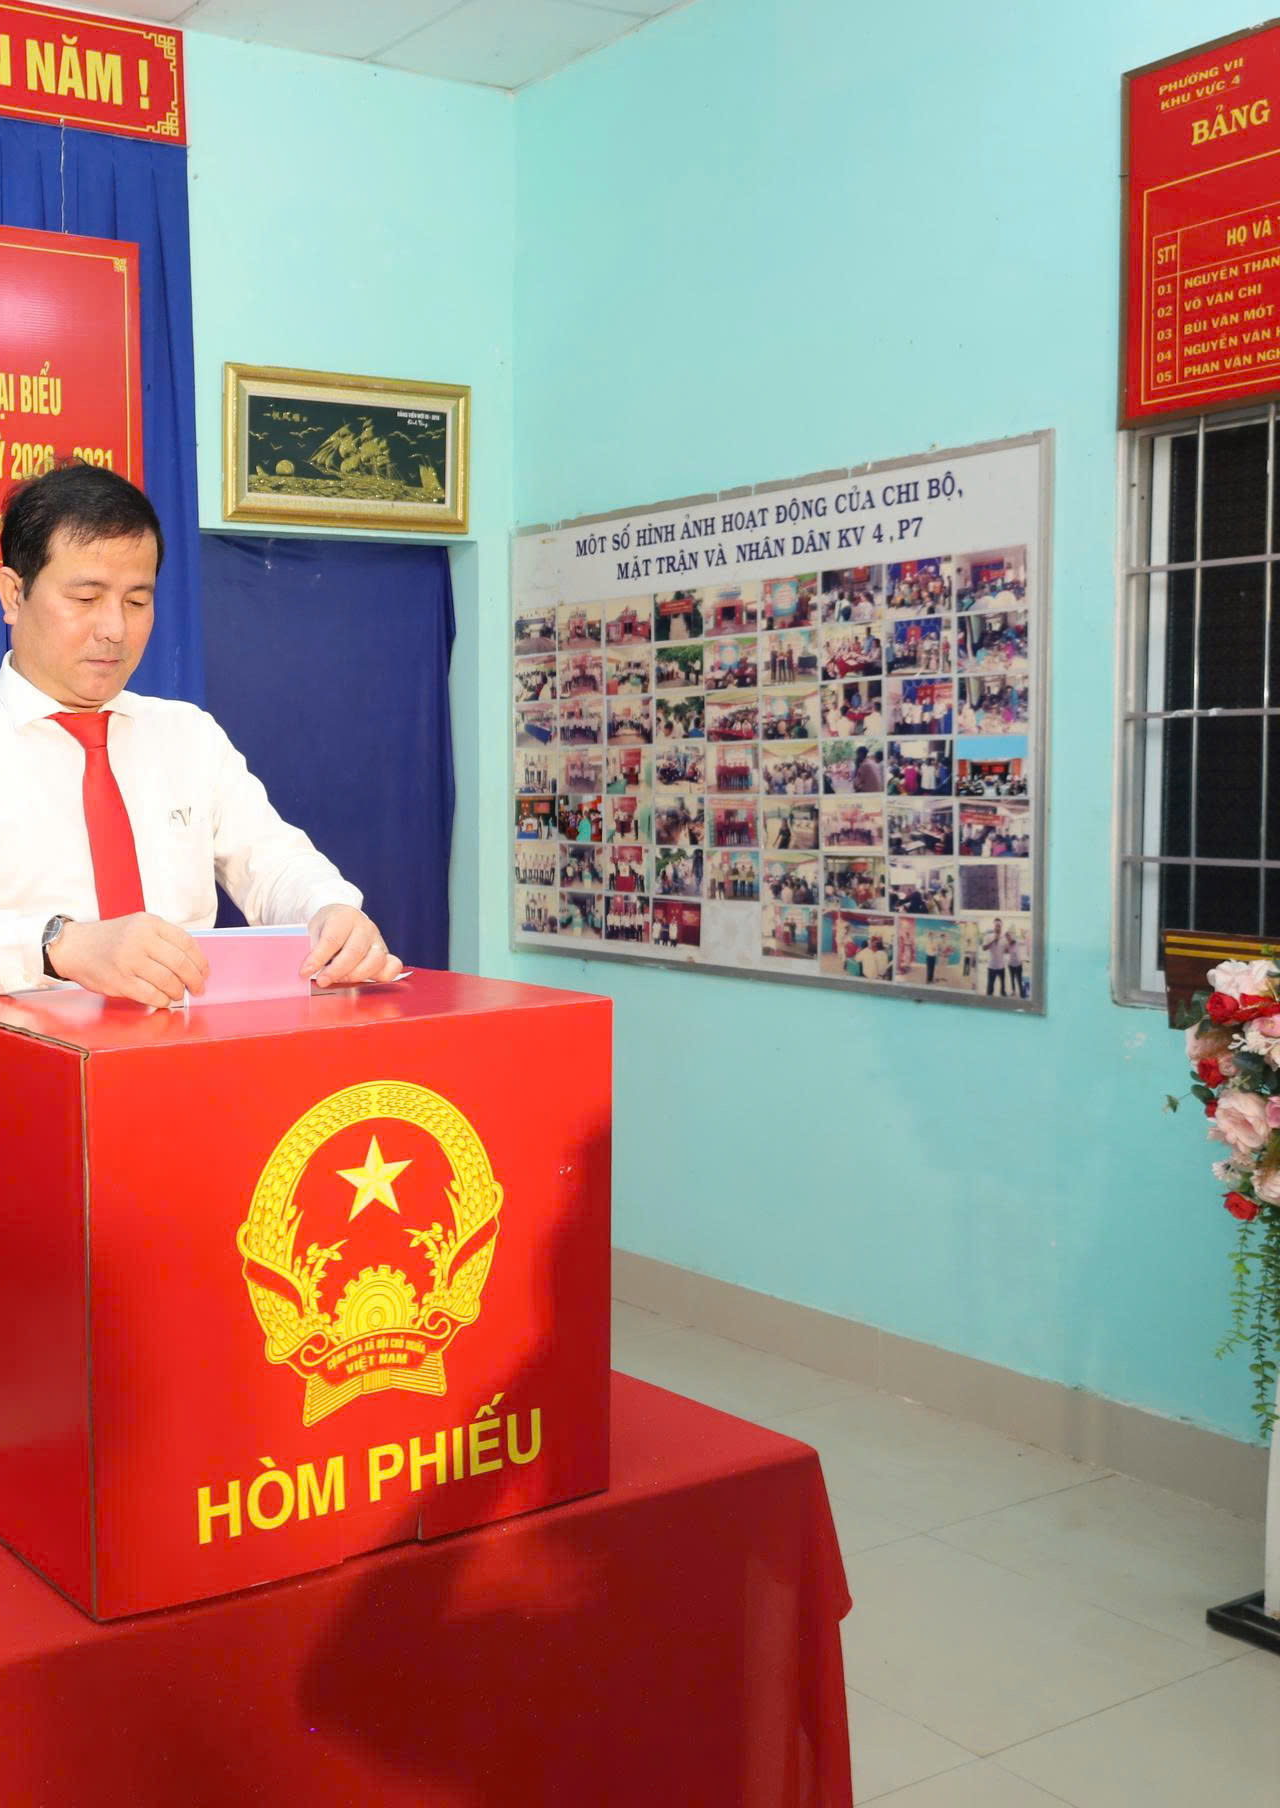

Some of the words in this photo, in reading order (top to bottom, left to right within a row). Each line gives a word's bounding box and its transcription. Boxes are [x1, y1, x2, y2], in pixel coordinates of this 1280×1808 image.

[25, 33, 123, 106] NĂM
[138, 59, 150, 110] !
[1158, 66, 1219, 96] PHƯỜNG
[1223, 57, 1244, 73] VII
[1160, 92, 1191, 111] KHU
[1231, 74, 1241, 85] 4
[1191, 98, 1271, 146] BẢNG
[1157, 244, 1177, 265] STT
[1226, 225, 1248, 247] HỌ
[1157, 283, 1172, 297] 01
[1157, 306, 1173, 319] 02
[1238, 283, 1262, 299] CHI
[1156, 328, 1172, 341] 03
[1156, 350, 1172, 363] 04
[1156, 371, 1172, 384] 05
[1183, 361, 1220, 378] PHAN
[19, 360, 62, 416] BIỂU
[10, 441, 55, 480] 2026
[611, 523, 631, 551] SỐ
[636, 522, 676, 547] HÌNH
[680, 513, 716, 540] ẢNH
[721, 507, 769, 533] HOẠT
[775, 498, 827, 525] ĐỘNG
[835, 485, 876, 514] CỦA
[882, 481, 919, 506] CHI
[927, 471, 963, 501] BỘ,
[616, 555, 652, 581] MẶT
[656, 549, 699, 575] TRẬN
[705, 543, 728, 568] VÀ
[735, 536, 786, 564] NHÂN
[792, 529, 831, 555] DÂN
[837, 525, 865, 549] KV
[378, 1353, 409, 1365] NAM
[196, 1455, 346, 1545] HÒM
[368, 1392, 542, 1503] PHIẾU
